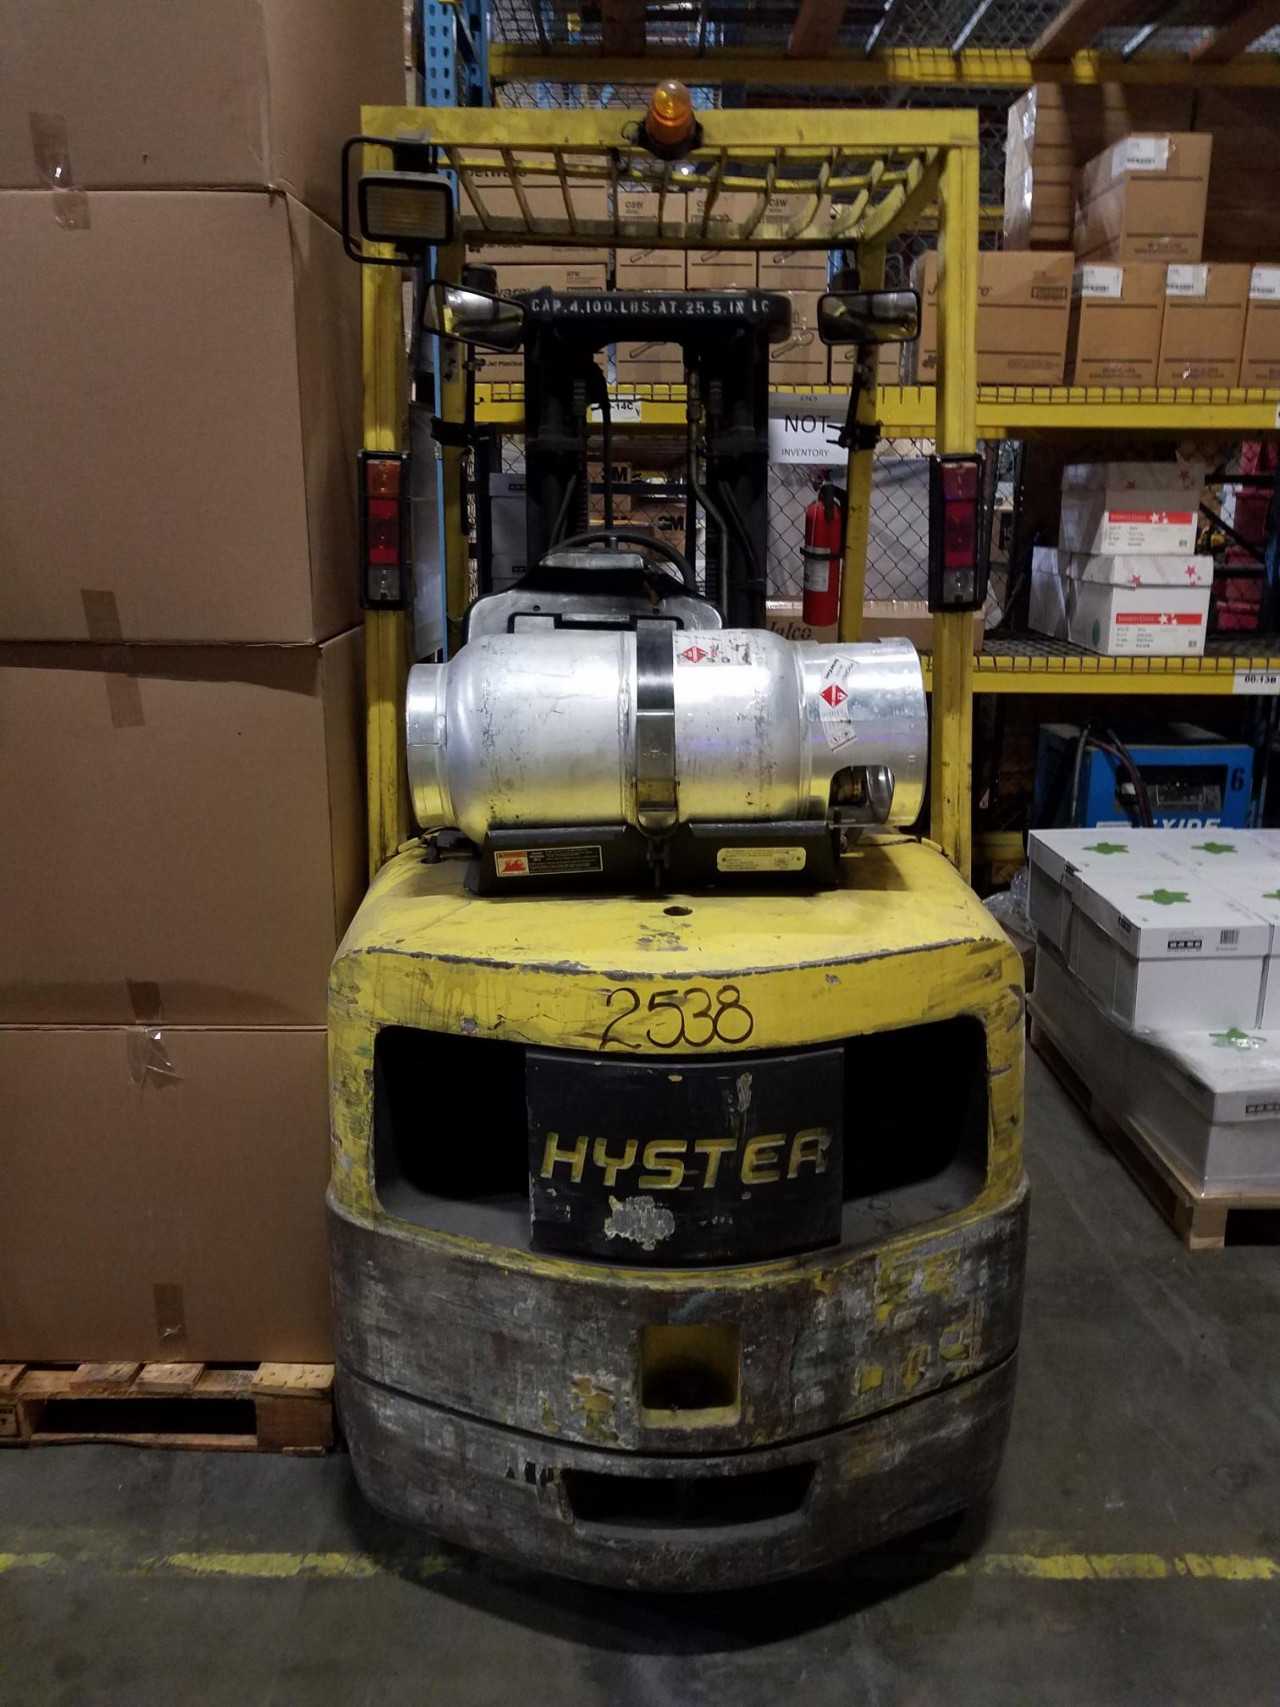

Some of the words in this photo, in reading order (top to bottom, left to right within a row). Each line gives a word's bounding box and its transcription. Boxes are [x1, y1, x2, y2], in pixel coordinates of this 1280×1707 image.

[785, 414, 831, 434] NOT
[781, 448, 830, 457] INVENTORY
[1230, 767, 1246, 792] 6
[598, 984, 755, 1050] 2538
